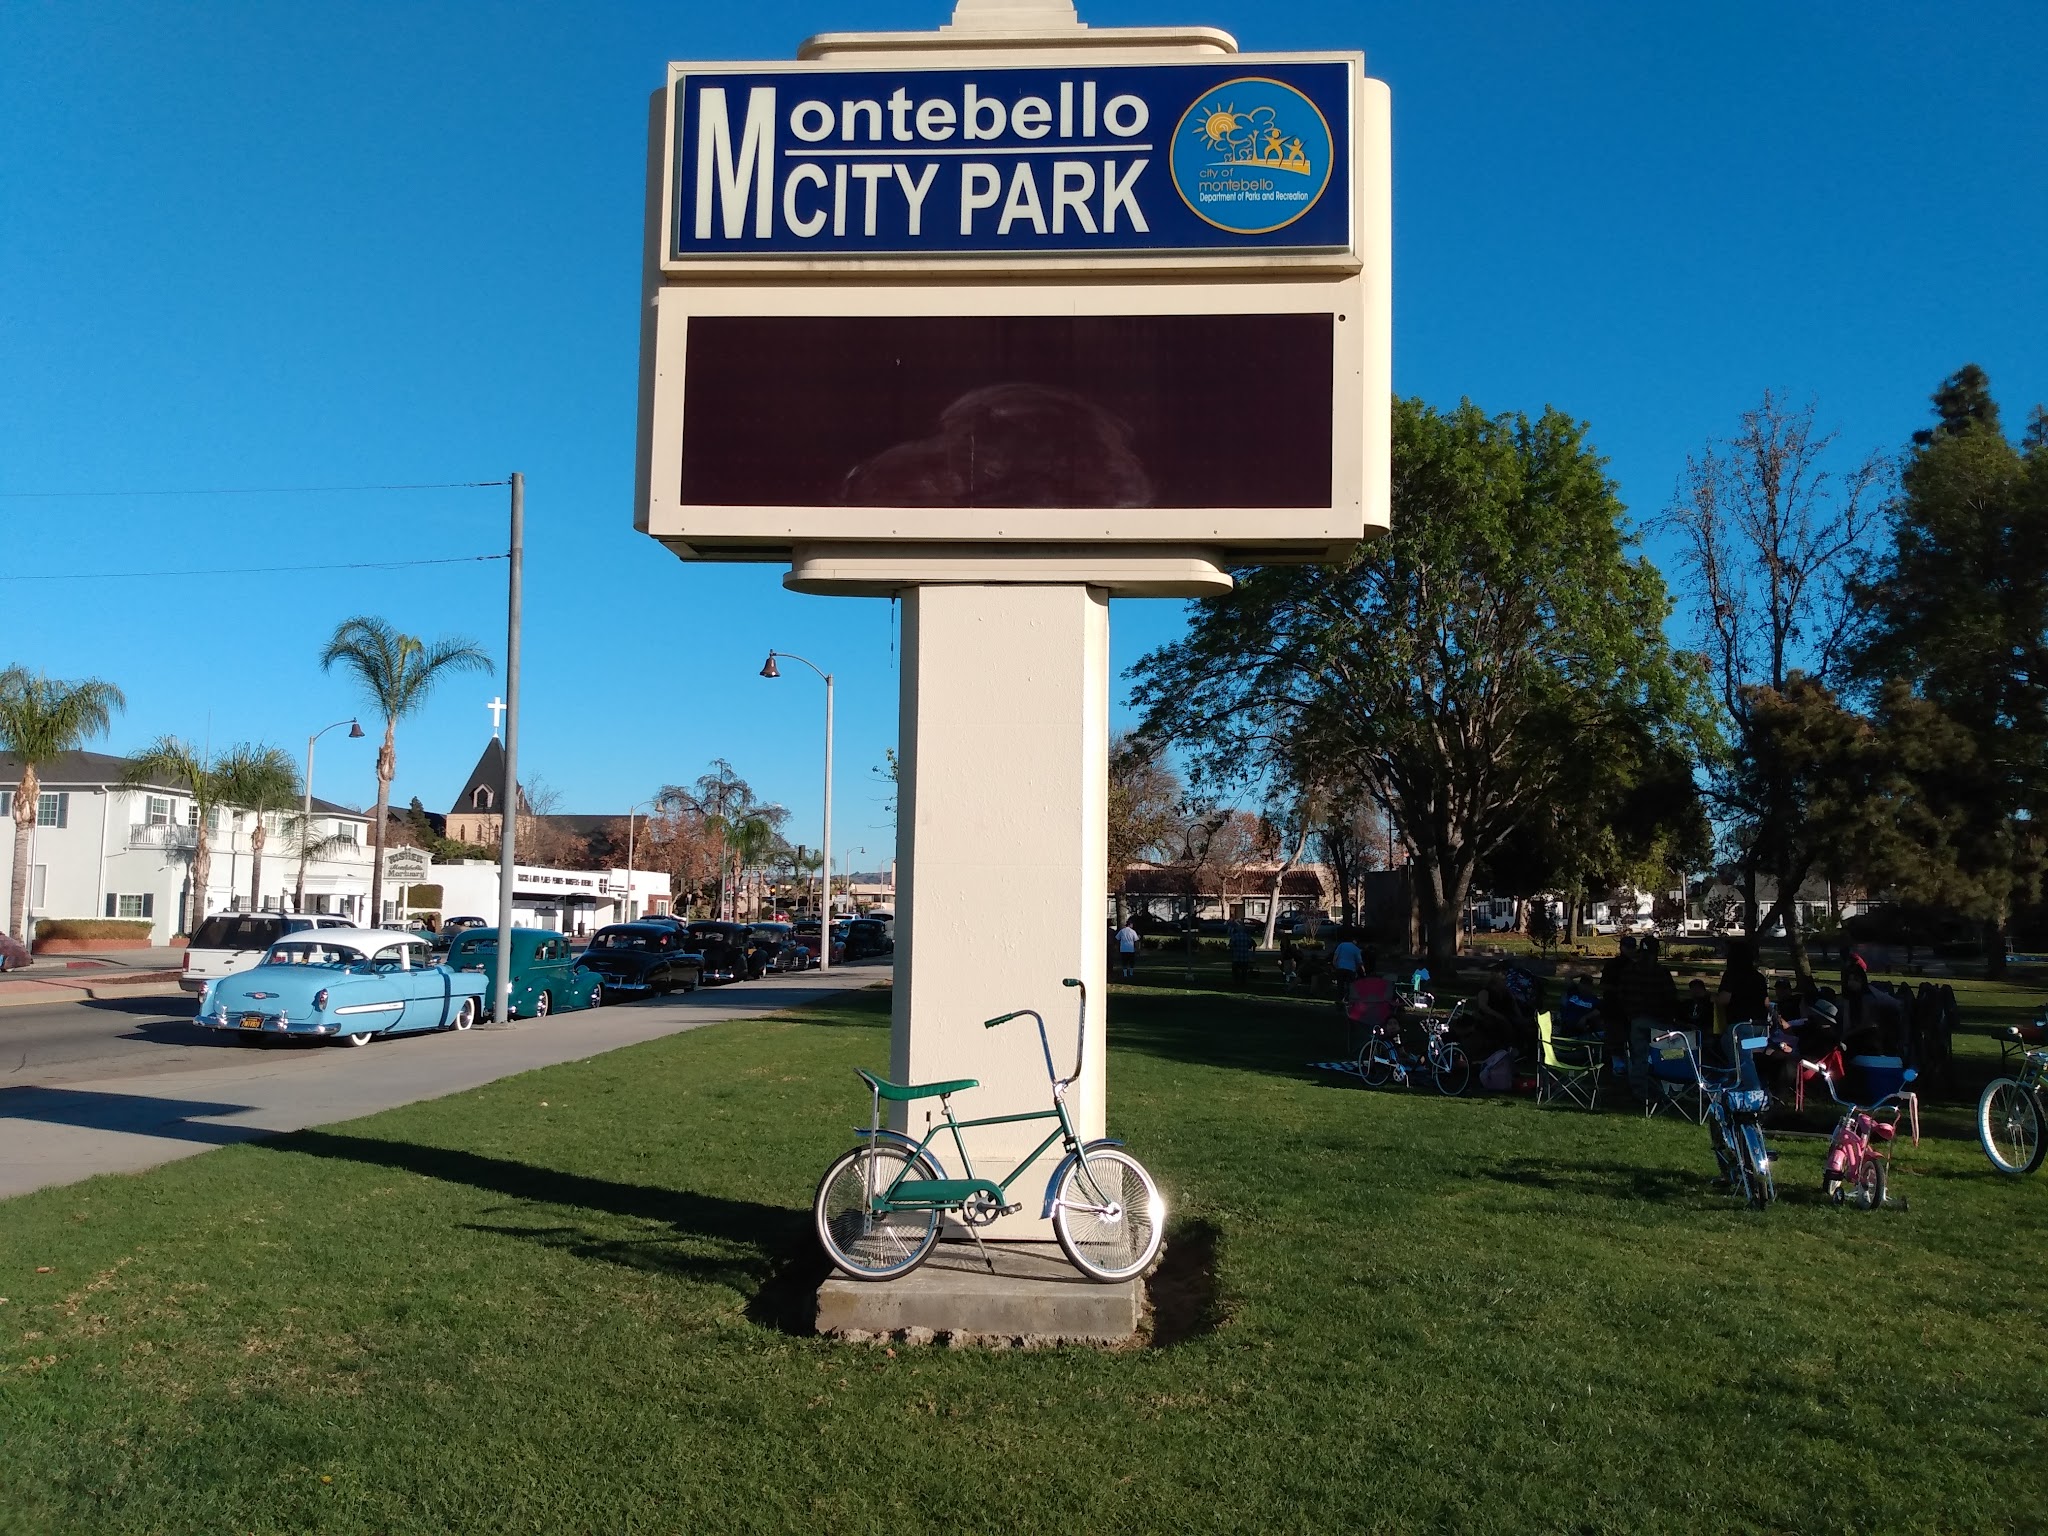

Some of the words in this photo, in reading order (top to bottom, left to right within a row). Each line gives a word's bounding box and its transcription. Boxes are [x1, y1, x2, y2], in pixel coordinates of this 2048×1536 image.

[695, 81, 1150, 241] Montebello
[1199, 168, 1218, 179] city
[1221, 168, 1234, 177] of
[1199, 179, 1274, 192] montebello
[783, 162, 941, 239] CITY
[960, 159, 1151, 236] PARK
[1200, 192, 1236, 203] Department
[1237, 191, 1244, 201] of
[1245, 191, 1261, 201] Parks
[1262, 190, 1274, 201] and
[1275, 190, 1309, 201] Recreation
[388, 870, 425, 878] Mortuary
